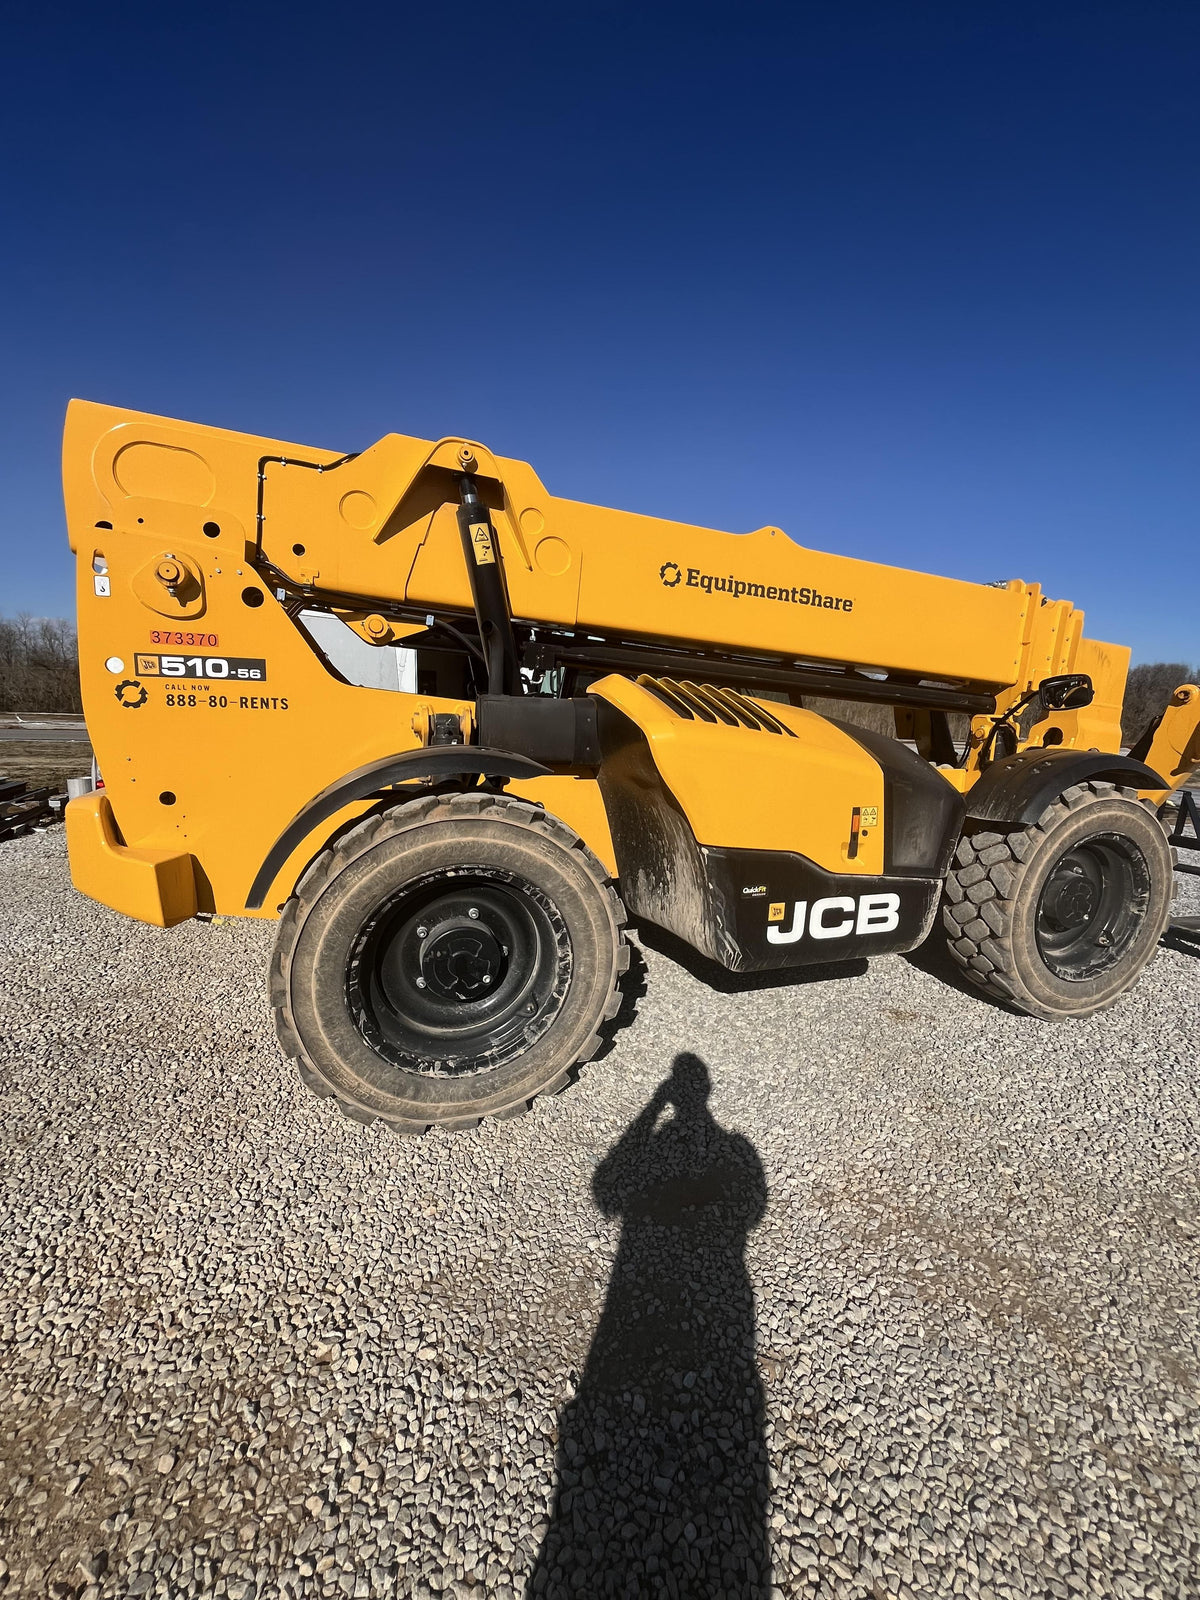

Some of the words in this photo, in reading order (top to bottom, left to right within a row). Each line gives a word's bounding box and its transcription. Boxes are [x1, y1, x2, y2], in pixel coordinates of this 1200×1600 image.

[685, 567, 854, 612] EquipmentShare
[151, 630, 217, 647] 373370
[160, 655, 262, 679] 510-56
[164, 683, 187, 691] CALL
[191, 684, 210, 692] NOW
[165, 693, 289, 710] 888-80-RENTS
[766, 892, 901, 945] JCB
